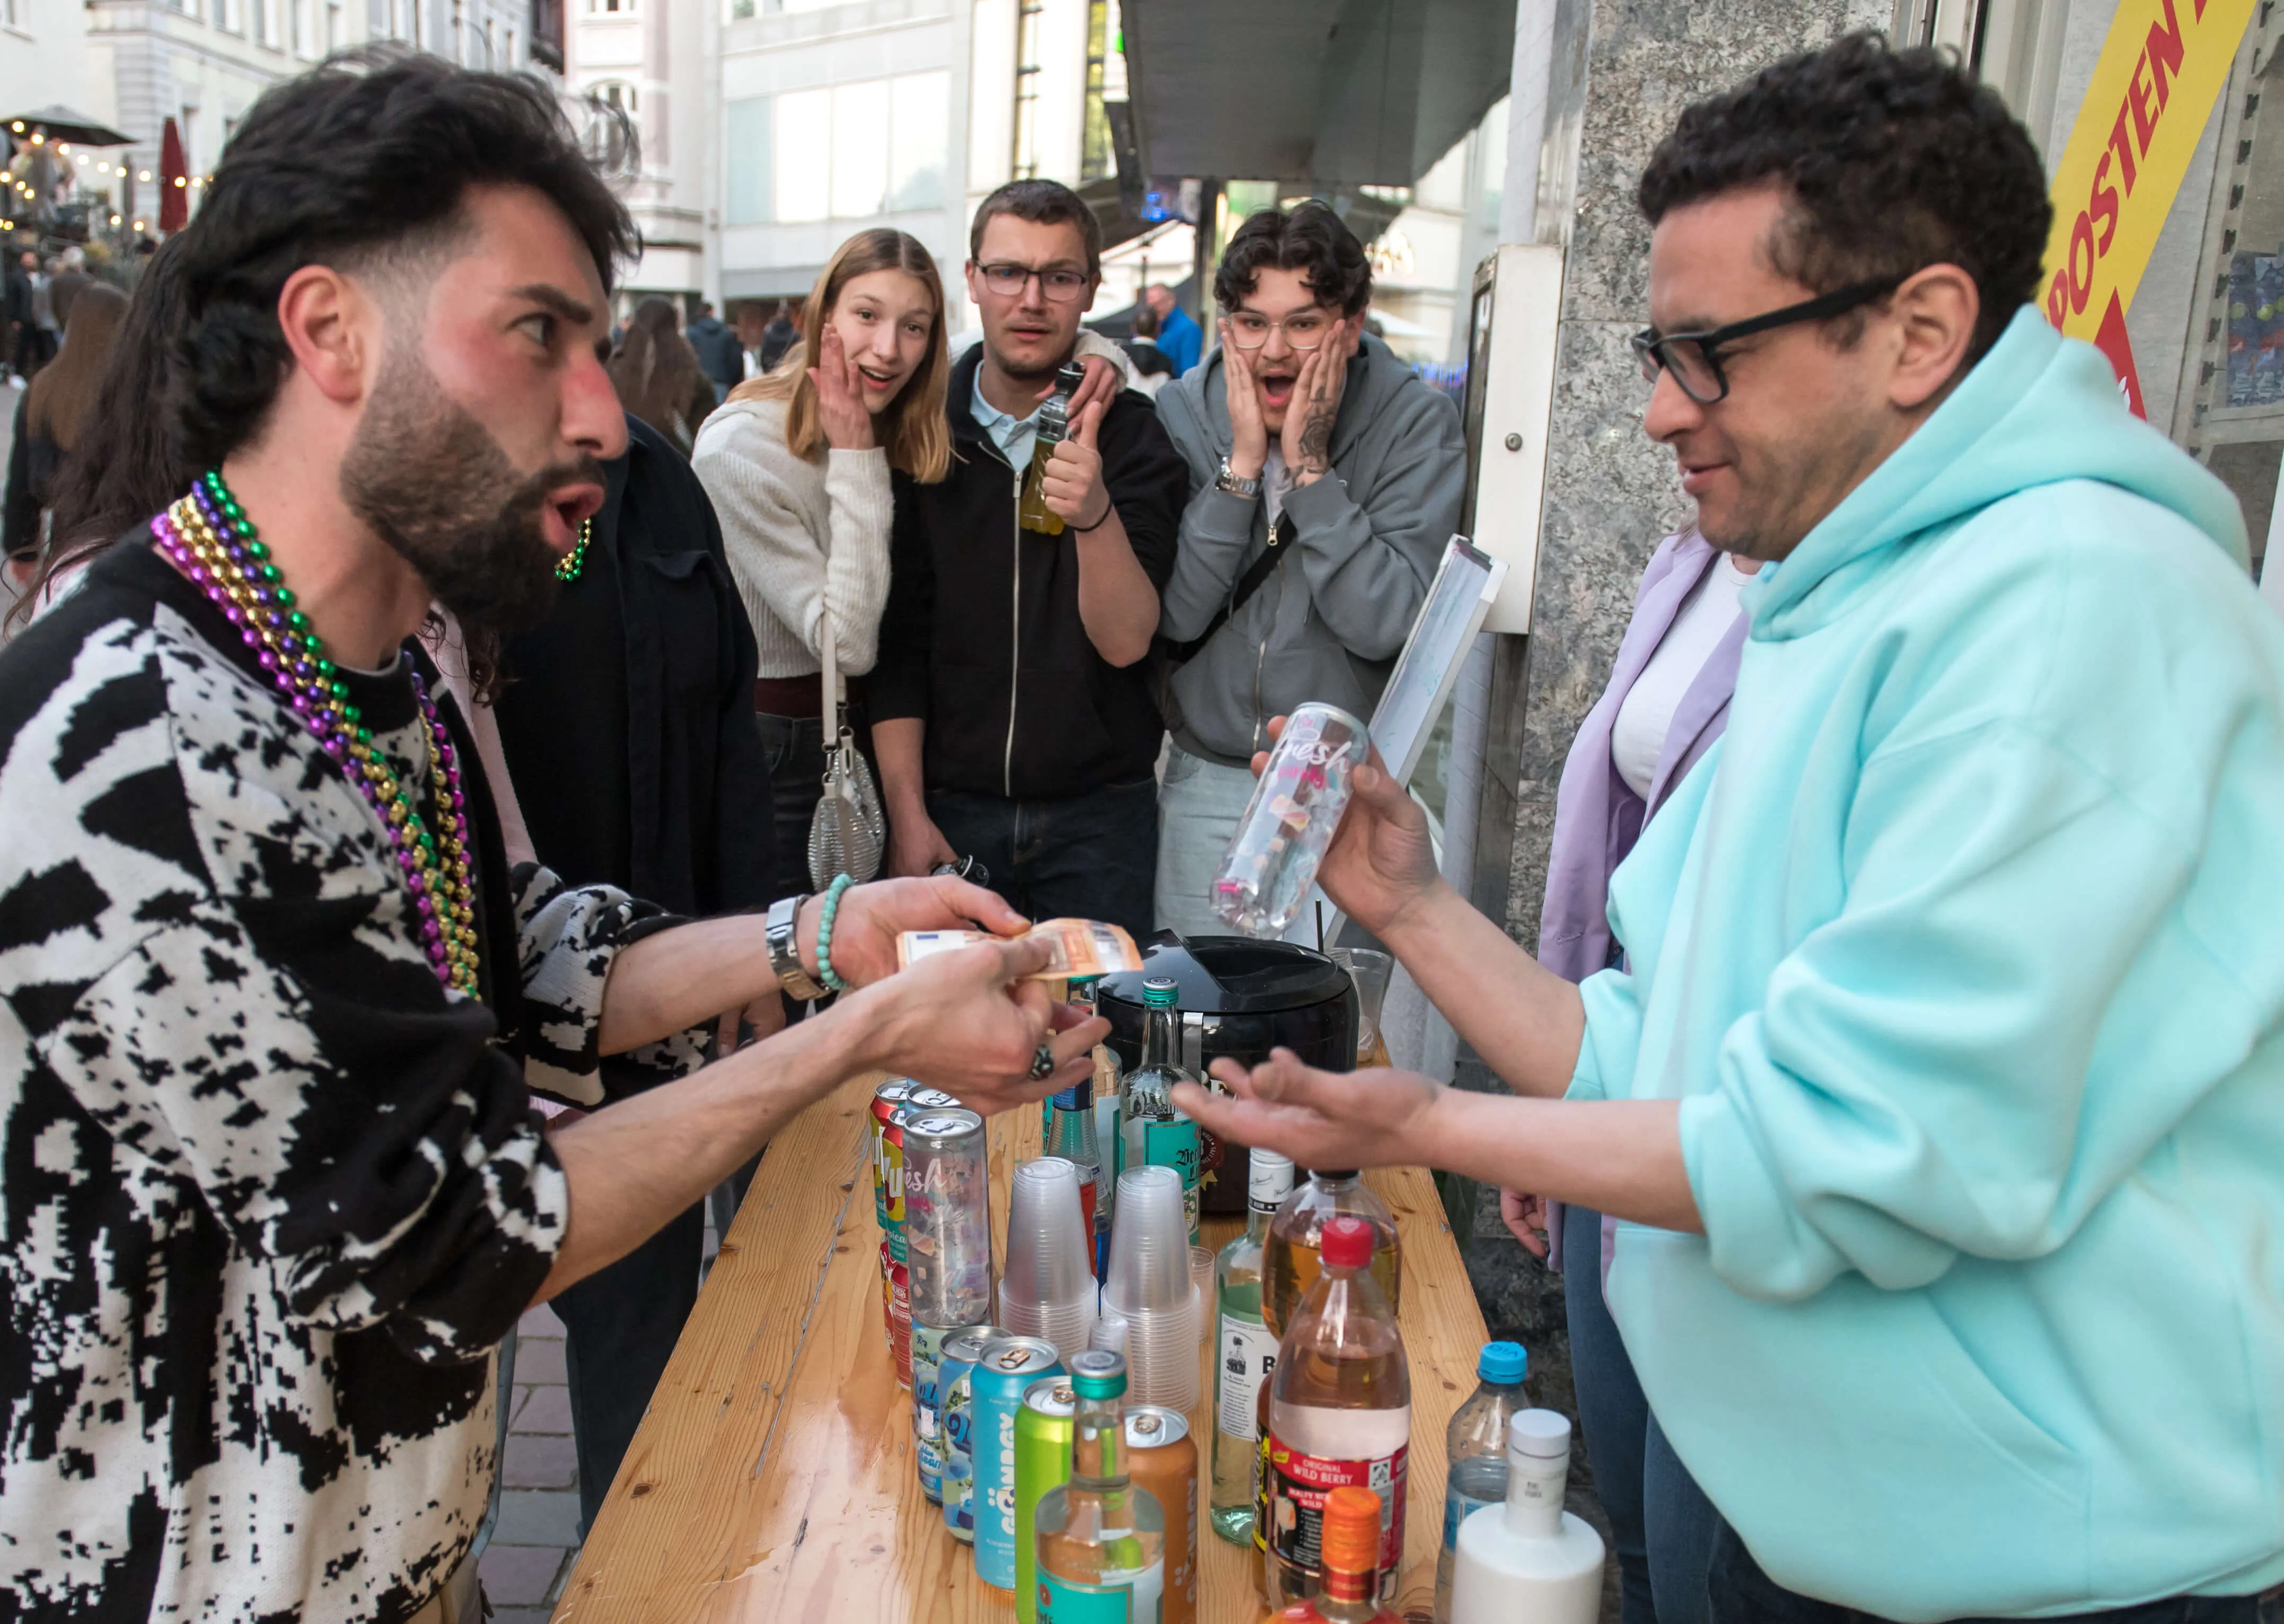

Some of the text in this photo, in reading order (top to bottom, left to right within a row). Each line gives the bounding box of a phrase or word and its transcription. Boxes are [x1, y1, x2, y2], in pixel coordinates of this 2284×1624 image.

[2045, 0, 2184, 335] POSTEN
[1292, 1463, 1353, 1485] WILD BERRY
[1302, 1459, 1341, 1473] ORIGINAL
